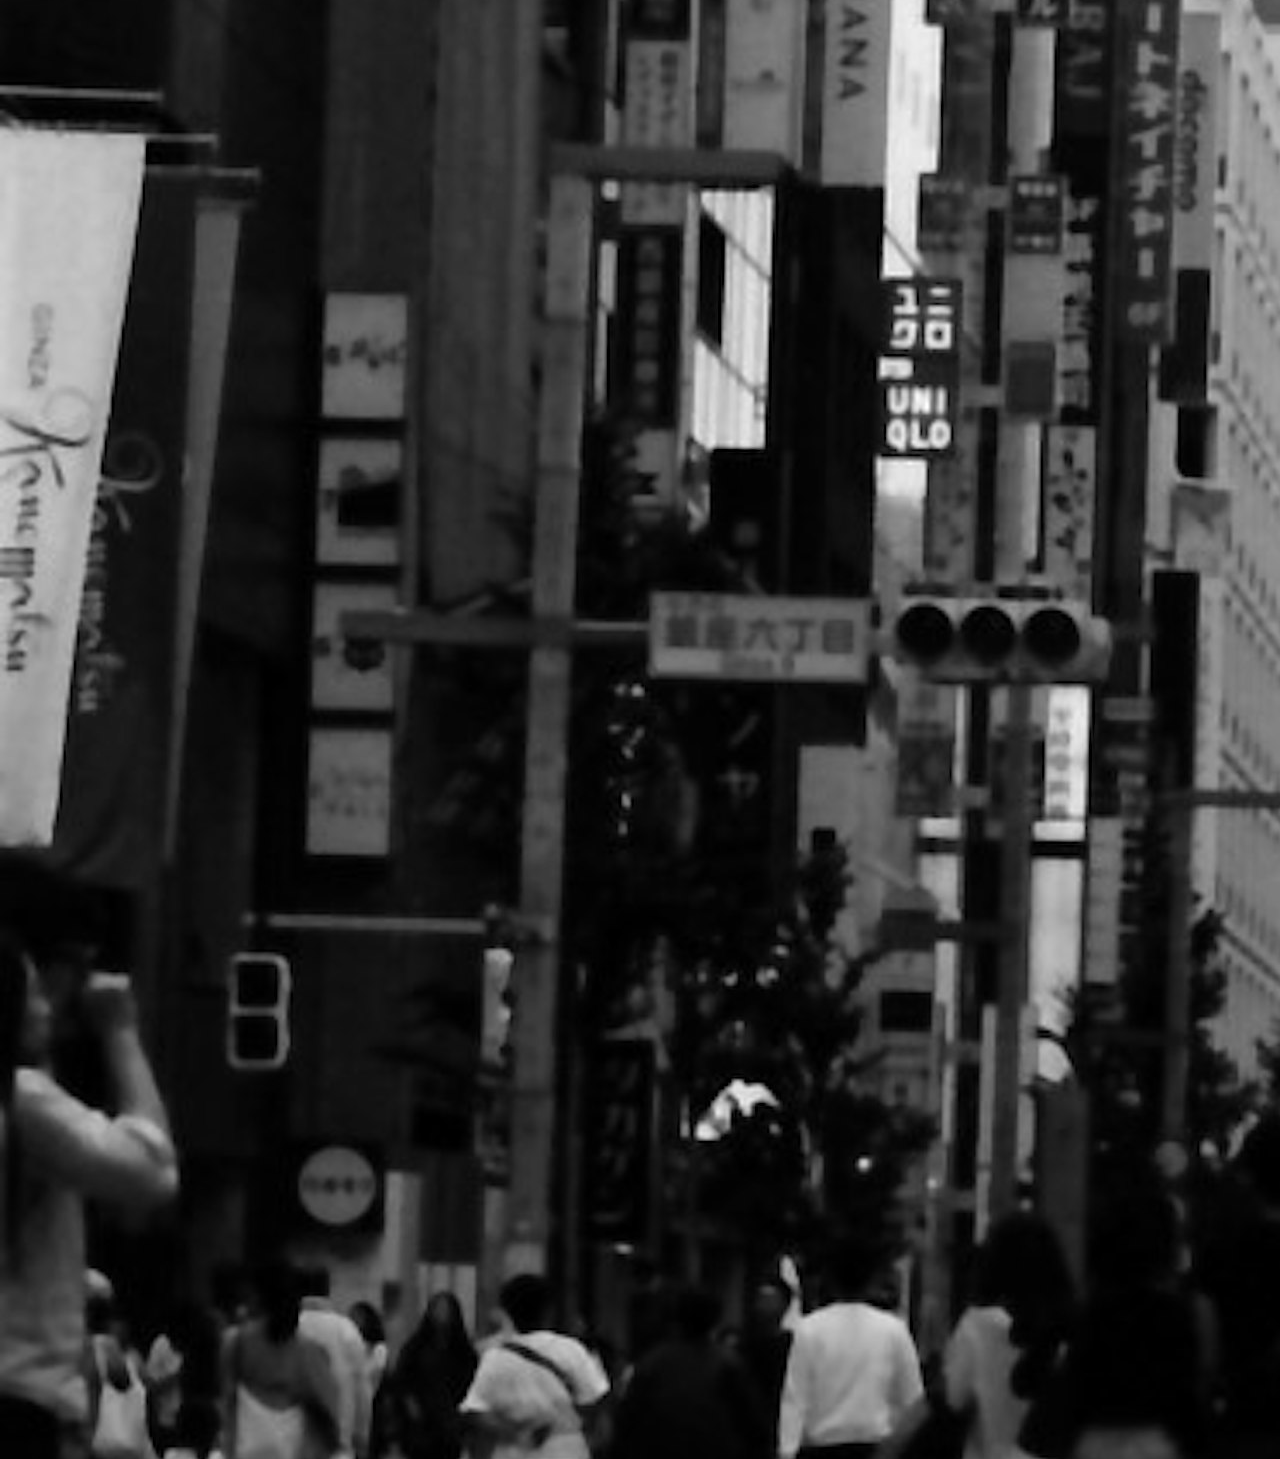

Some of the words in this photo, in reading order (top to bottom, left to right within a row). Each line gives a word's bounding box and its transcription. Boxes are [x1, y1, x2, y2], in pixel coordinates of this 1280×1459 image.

[1179, 70, 1208, 213] docomo
[889, 387, 946, 415] UNI
[887, 418, 951, 452] QLO
